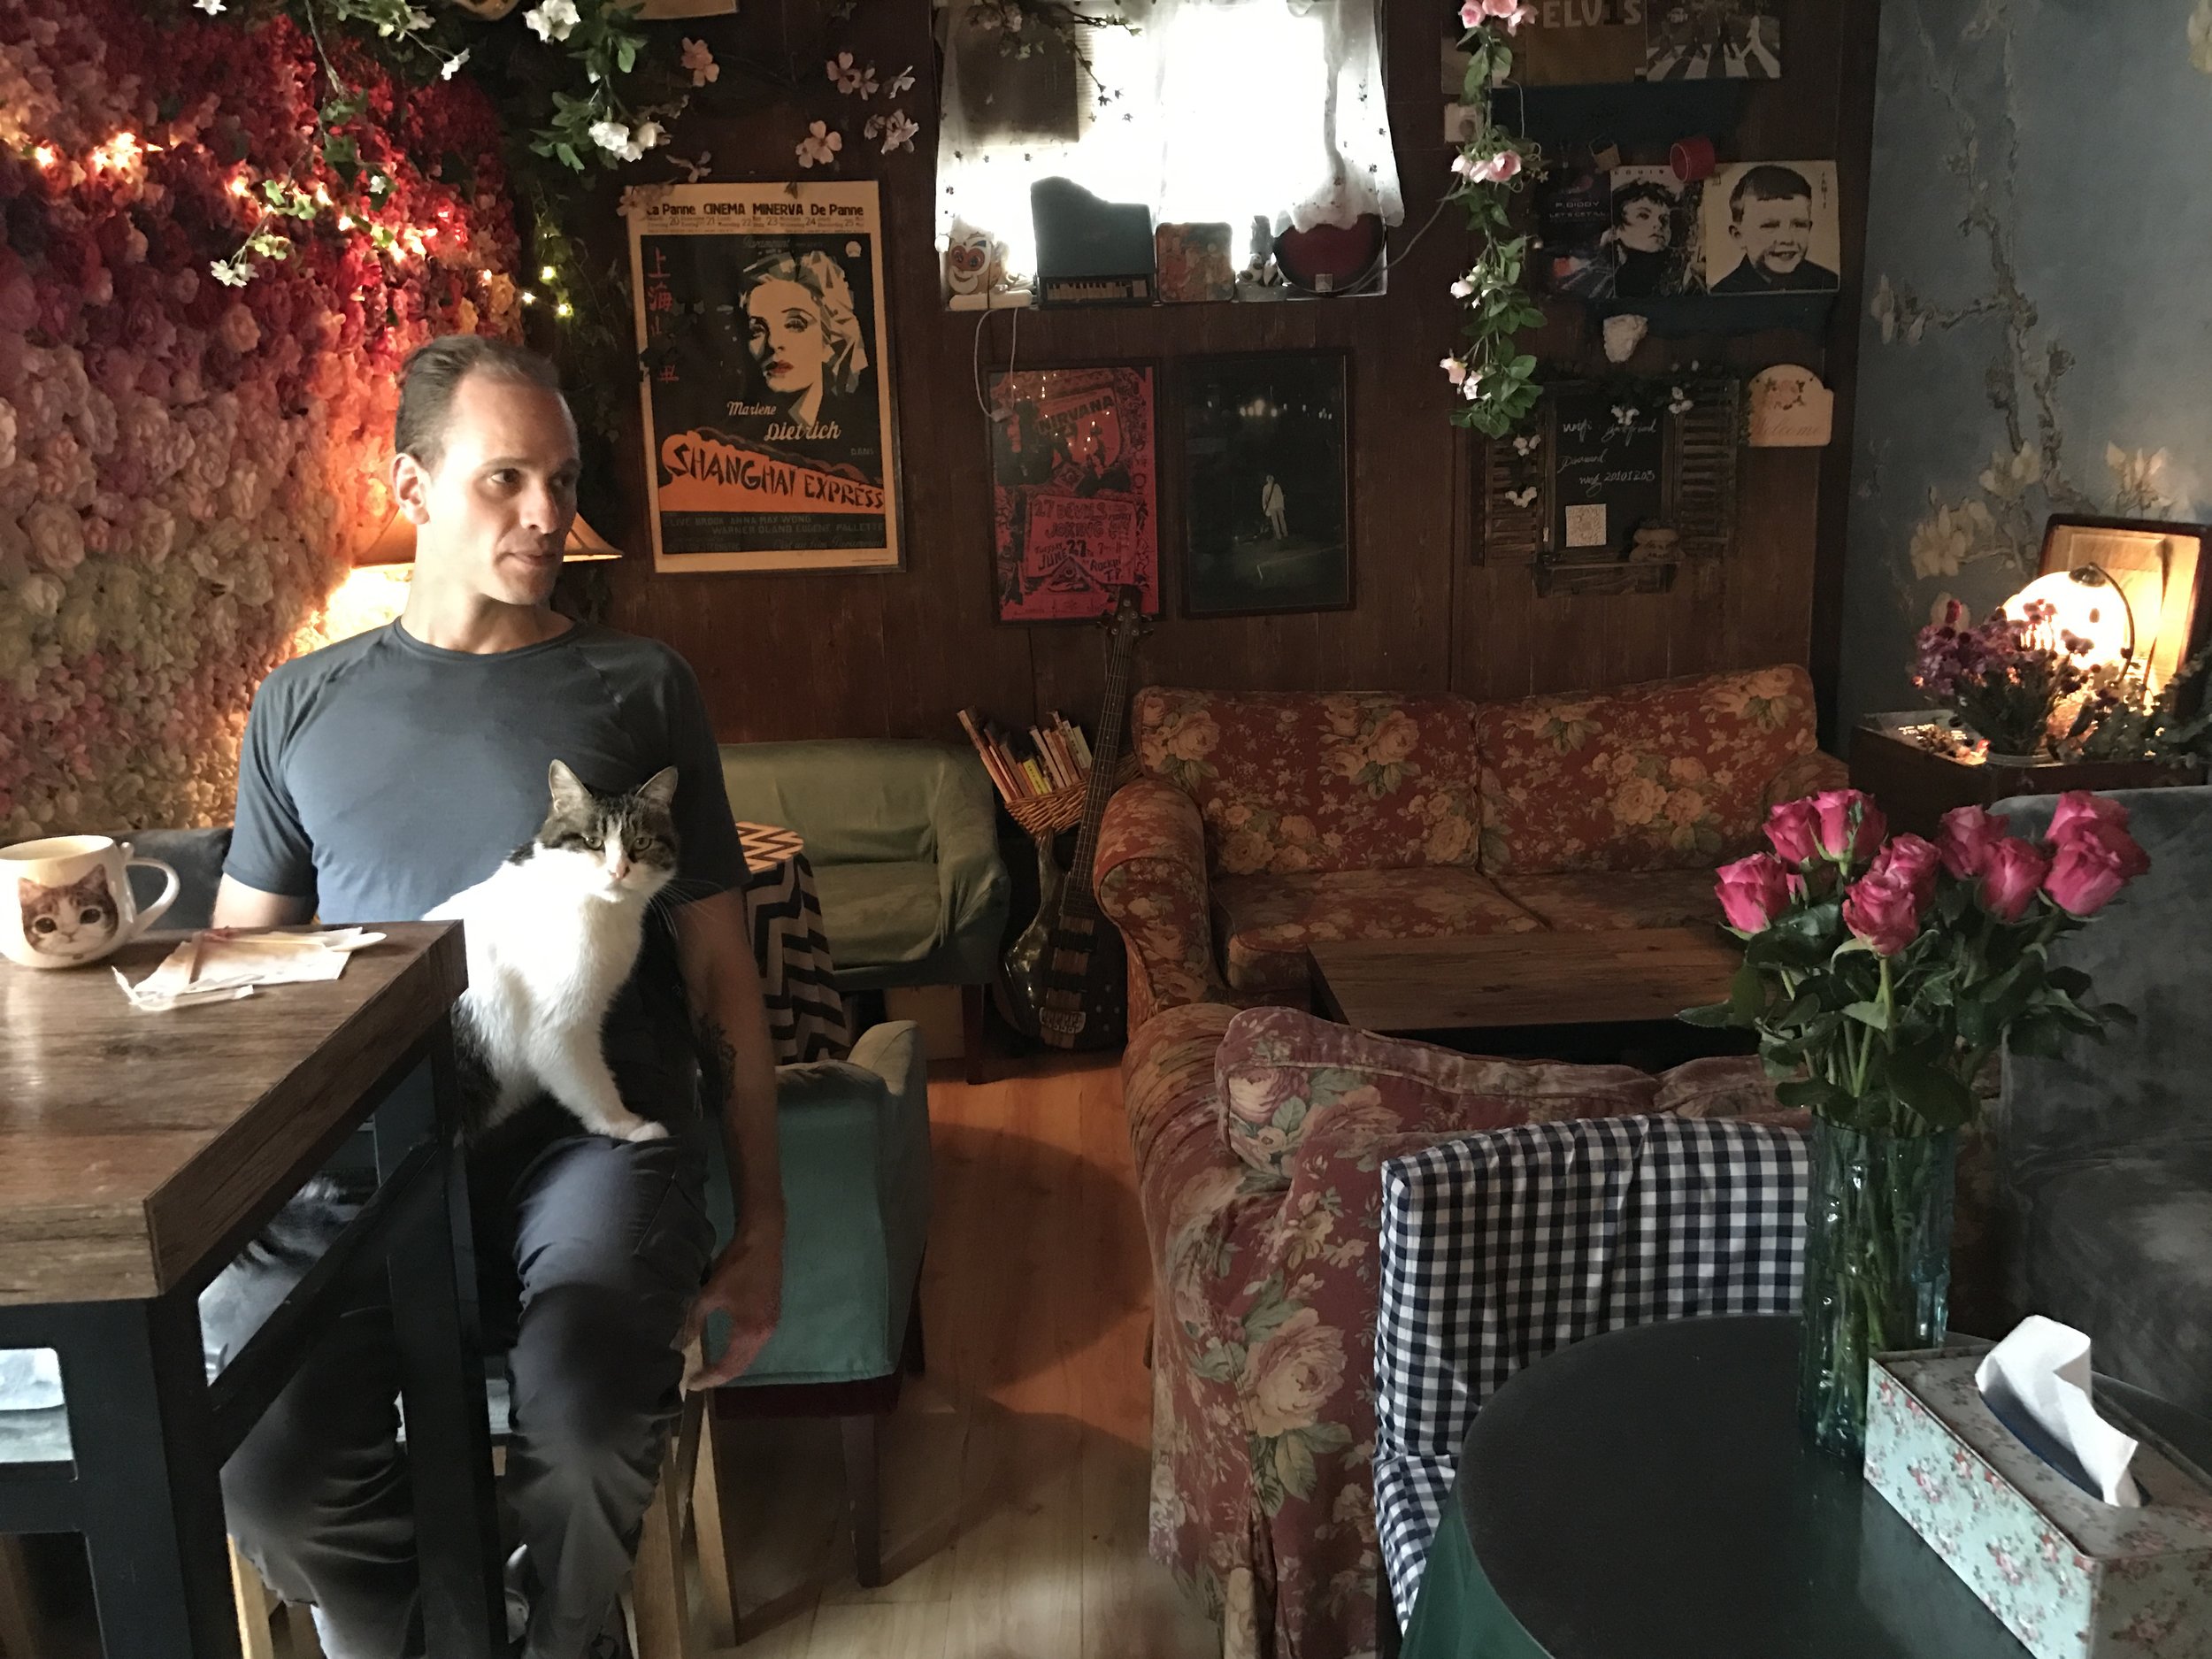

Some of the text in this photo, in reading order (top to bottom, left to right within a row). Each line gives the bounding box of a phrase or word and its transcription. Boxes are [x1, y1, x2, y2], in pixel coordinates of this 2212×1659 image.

[662, 204, 696, 216] Panne
[703, 203, 746, 216] CINEMA
[752, 203, 803, 216] MINERVA
[810, 204, 826, 216] De
[829, 204, 864, 216] Panne
[766, 216, 779, 227] 23
[806, 217, 816, 227] 24
[726, 401, 777, 416] Marlene
[1035, 395, 1114, 436] NIRVANA
[764, 420, 841, 442] Dietrich
[665, 443, 884, 509] SHANGHAI EXPRESS
[1033, 499, 1056, 518] 27
[730, 516, 757, 525] ANNA
[759, 516, 779, 525] MAY
[781, 515, 812, 524] WONG
[711, 525, 757, 535] WARNER
[758, 524, 793, 534] OLAND
[1038, 548, 1067, 571] JUNE
